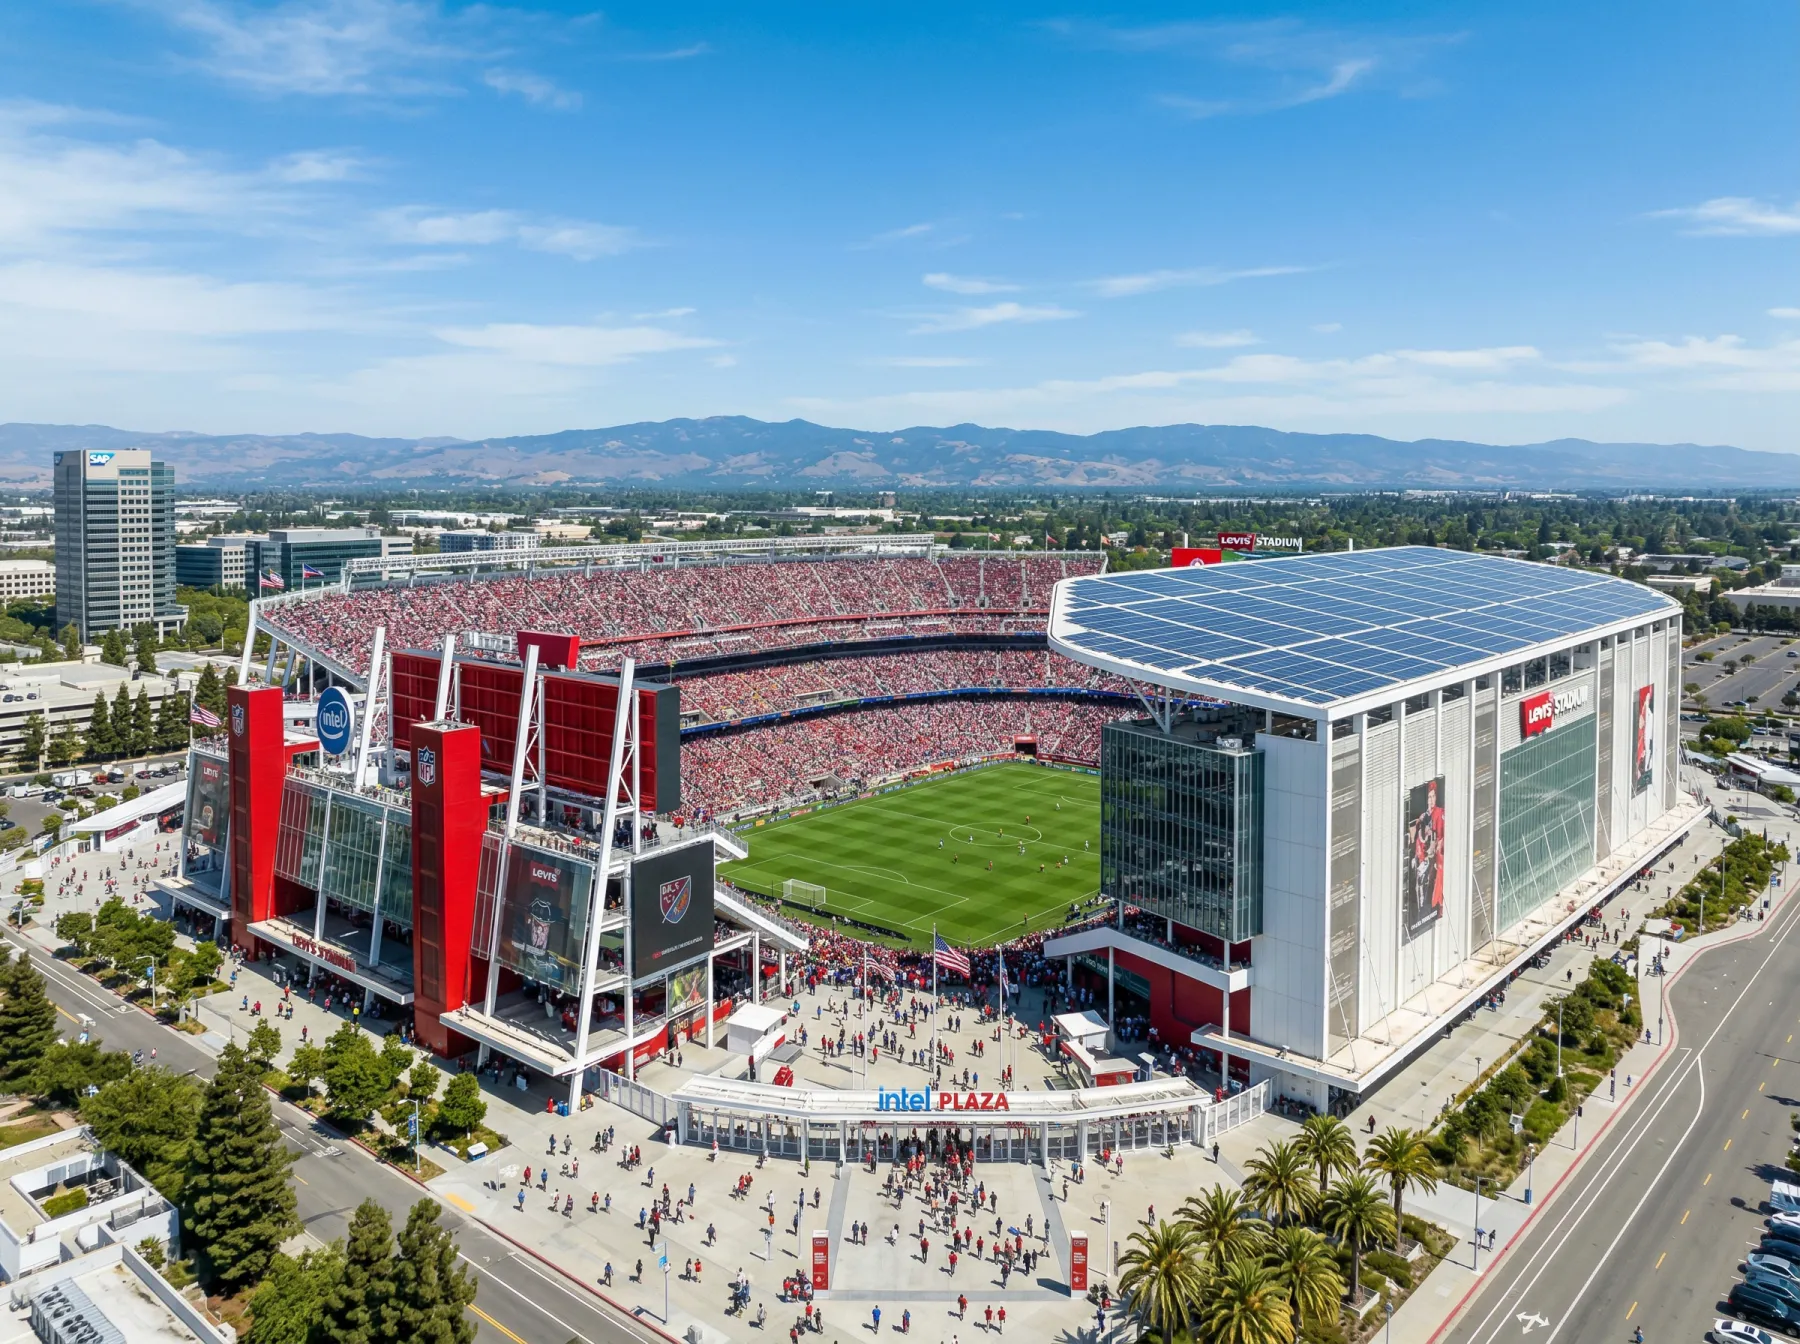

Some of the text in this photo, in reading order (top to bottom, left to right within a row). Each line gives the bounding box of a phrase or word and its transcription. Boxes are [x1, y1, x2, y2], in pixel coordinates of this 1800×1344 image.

[89, 454, 110, 464] SAP
[1256, 536, 1303, 547] STADIUM
[323, 707, 344, 728] intel
[878, 1085, 1010, 1111] intel PLAZA
